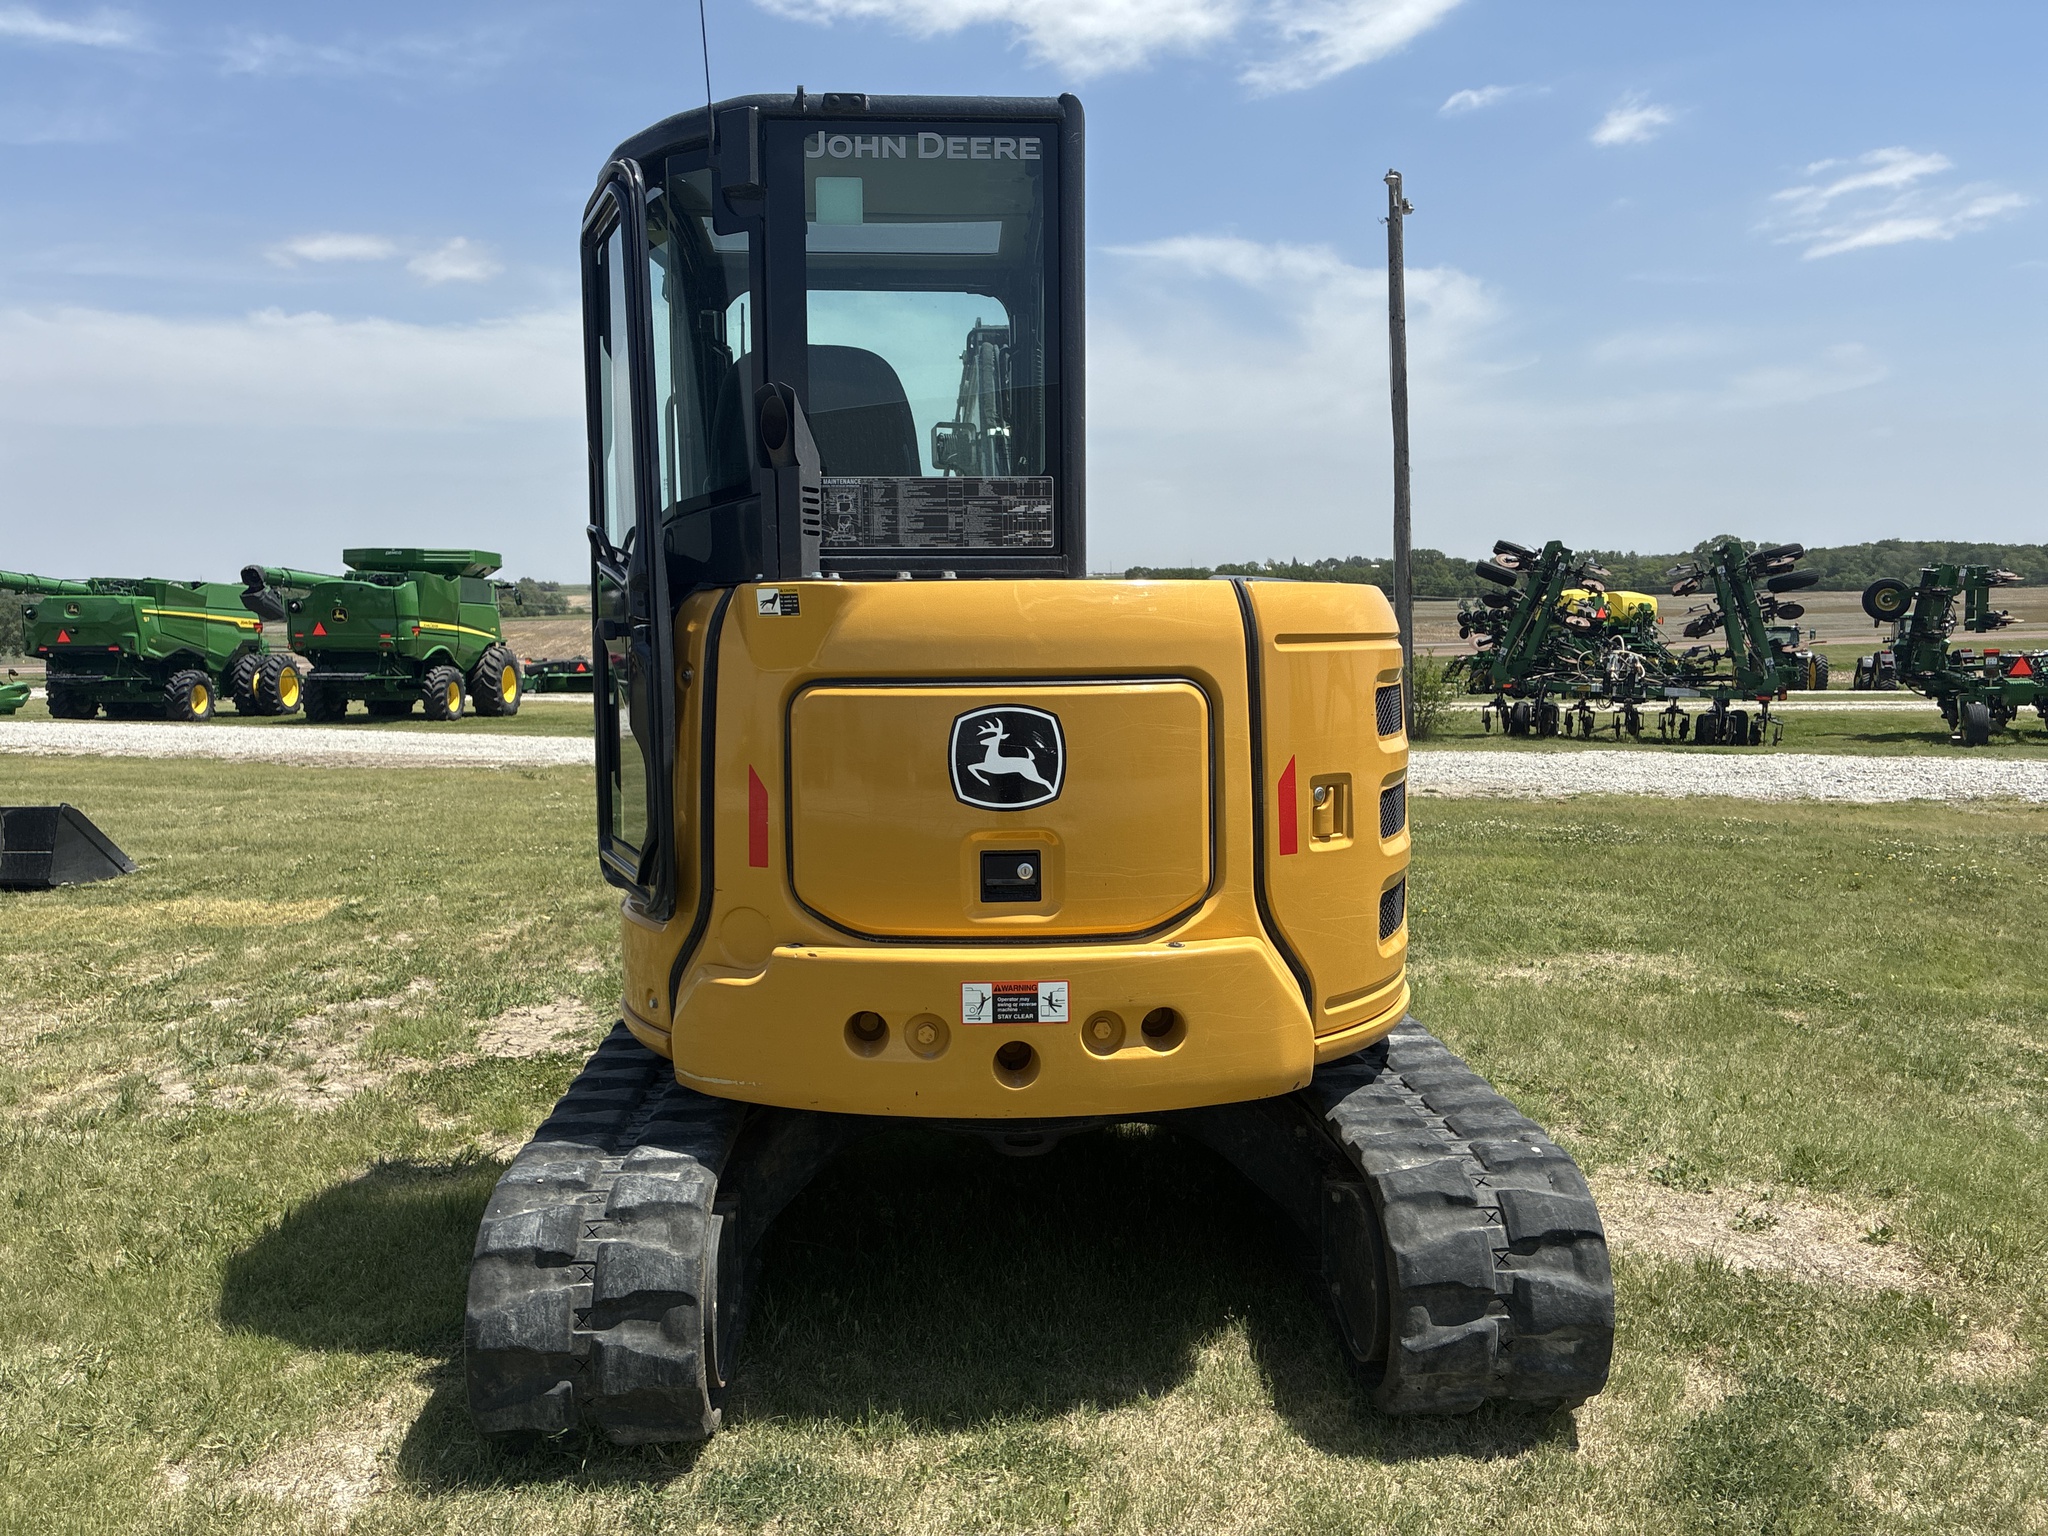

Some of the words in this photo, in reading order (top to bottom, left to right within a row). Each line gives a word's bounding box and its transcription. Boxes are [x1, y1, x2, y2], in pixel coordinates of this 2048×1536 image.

[806, 131, 906, 159] JOHN
[917, 132, 1041, 160] DEERE
[1001, 984, 1038, 992] WARNING
